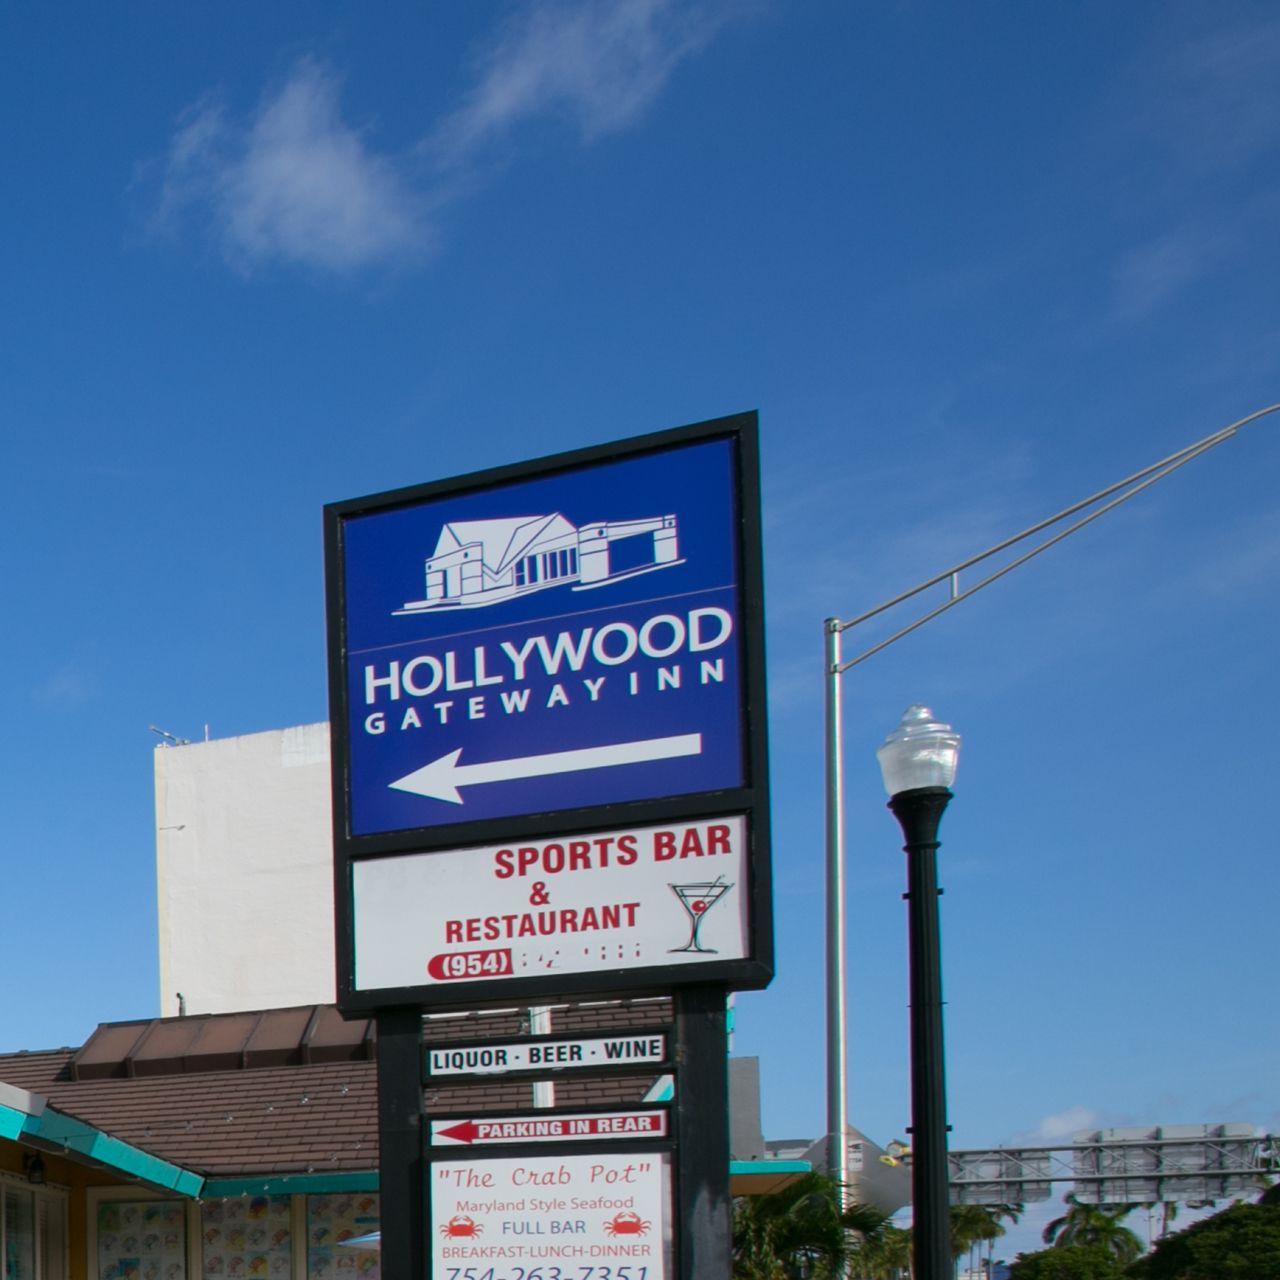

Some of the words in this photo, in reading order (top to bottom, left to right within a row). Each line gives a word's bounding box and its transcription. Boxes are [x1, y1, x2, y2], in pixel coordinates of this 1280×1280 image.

[364, 607, 733, 704] HOLLYWOOD
[364, 677, 605, 735] GATEWAY
[630, 658, 724, 696] INN
[494, 835, 638, 879] SPORTS
[653, 824, 732, 862] BAR
[529, 881, 550, 906] &
[445, 902, 640, 943] RESTAURANT
[441, 950, 508, 978] (954)
[433, 1049, 507, 1071] LIQUOR
[529, 1044, 582, 1063] BEER
[604, 1039, 661, 1059] WINE
[478, 1120, 562, 1138] PARKING
[569, 1119, 589, 1134] IN
[597, 1117, 651, 1132] REAR
[511, 1165, 571, 1186] Crab
[456, 1199, 525, 1214] Maryland
[530, 1198, 566, 1212] Style
[570, 1197, 634, 1210] Seafood
[502, 1220, 545, 1235] FULL
[550, 1220, 586, 1234] BAR
